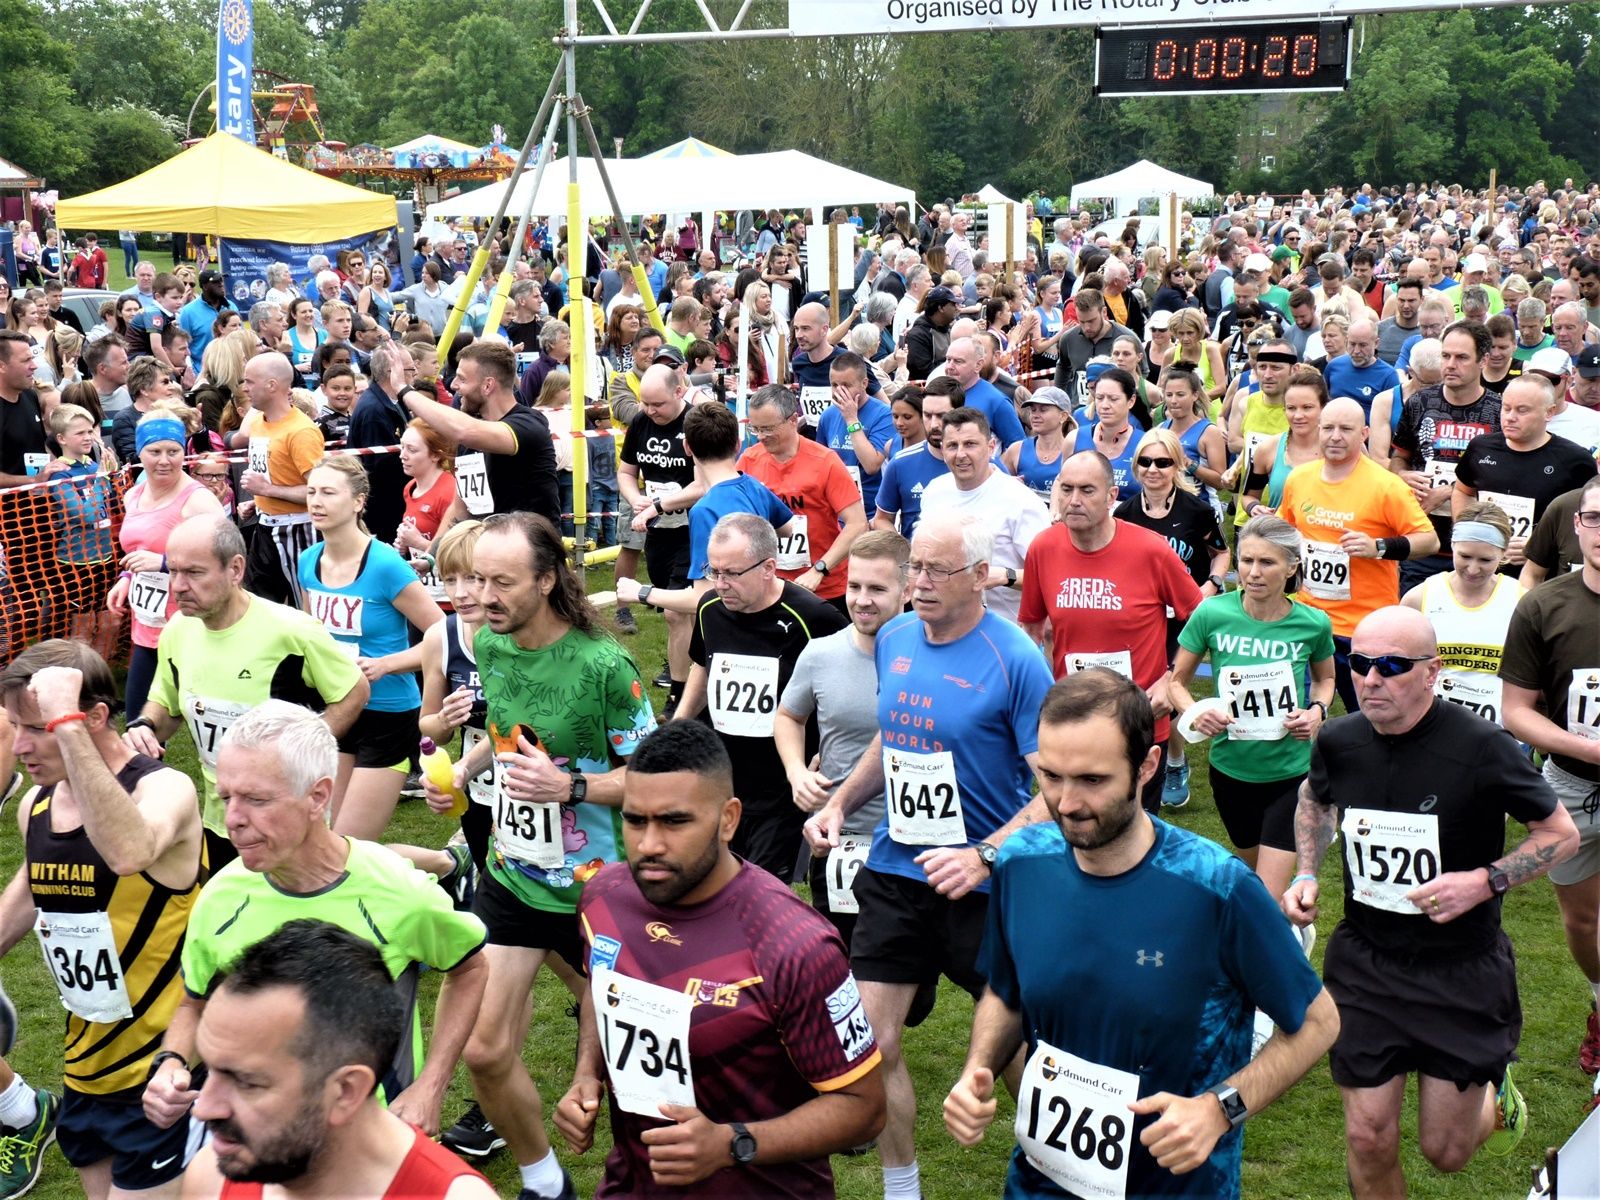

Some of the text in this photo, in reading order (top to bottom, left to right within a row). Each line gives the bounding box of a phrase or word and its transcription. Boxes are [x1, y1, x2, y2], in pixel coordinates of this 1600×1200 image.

[1153, 34, 1317, 79] 0:00:20
[1306, 515, 1344, 528] Control
[1315, 507, 1354, 520] Ground
[1069, 578, 1104, 596] RED
[1056, 594, 1122, 611] RUNNERS
[1216, 633, 1304, 661] WENDY
[715, 679, 774, 714] 1226
[898, 691, 932, 709] RUN
[890, 710, 935, 731] YOUR
[885, 729, 944, 753] WORLD
[889, 777, 957, 819] 1642
[497, 793, 553, 843] 1431
[31, 863, 95, 882] WITHAM
[1353, 841, 1438, 886] 1520
[71, 885, 96, 897] CLUB
[602, 1012, 688, 1086] 1734
[1057, 1066, 1099, 1088] Edmund
[1101, 1082, 1124, 1096] Carr
[1027, 1086, 1126, 1171] 1268
